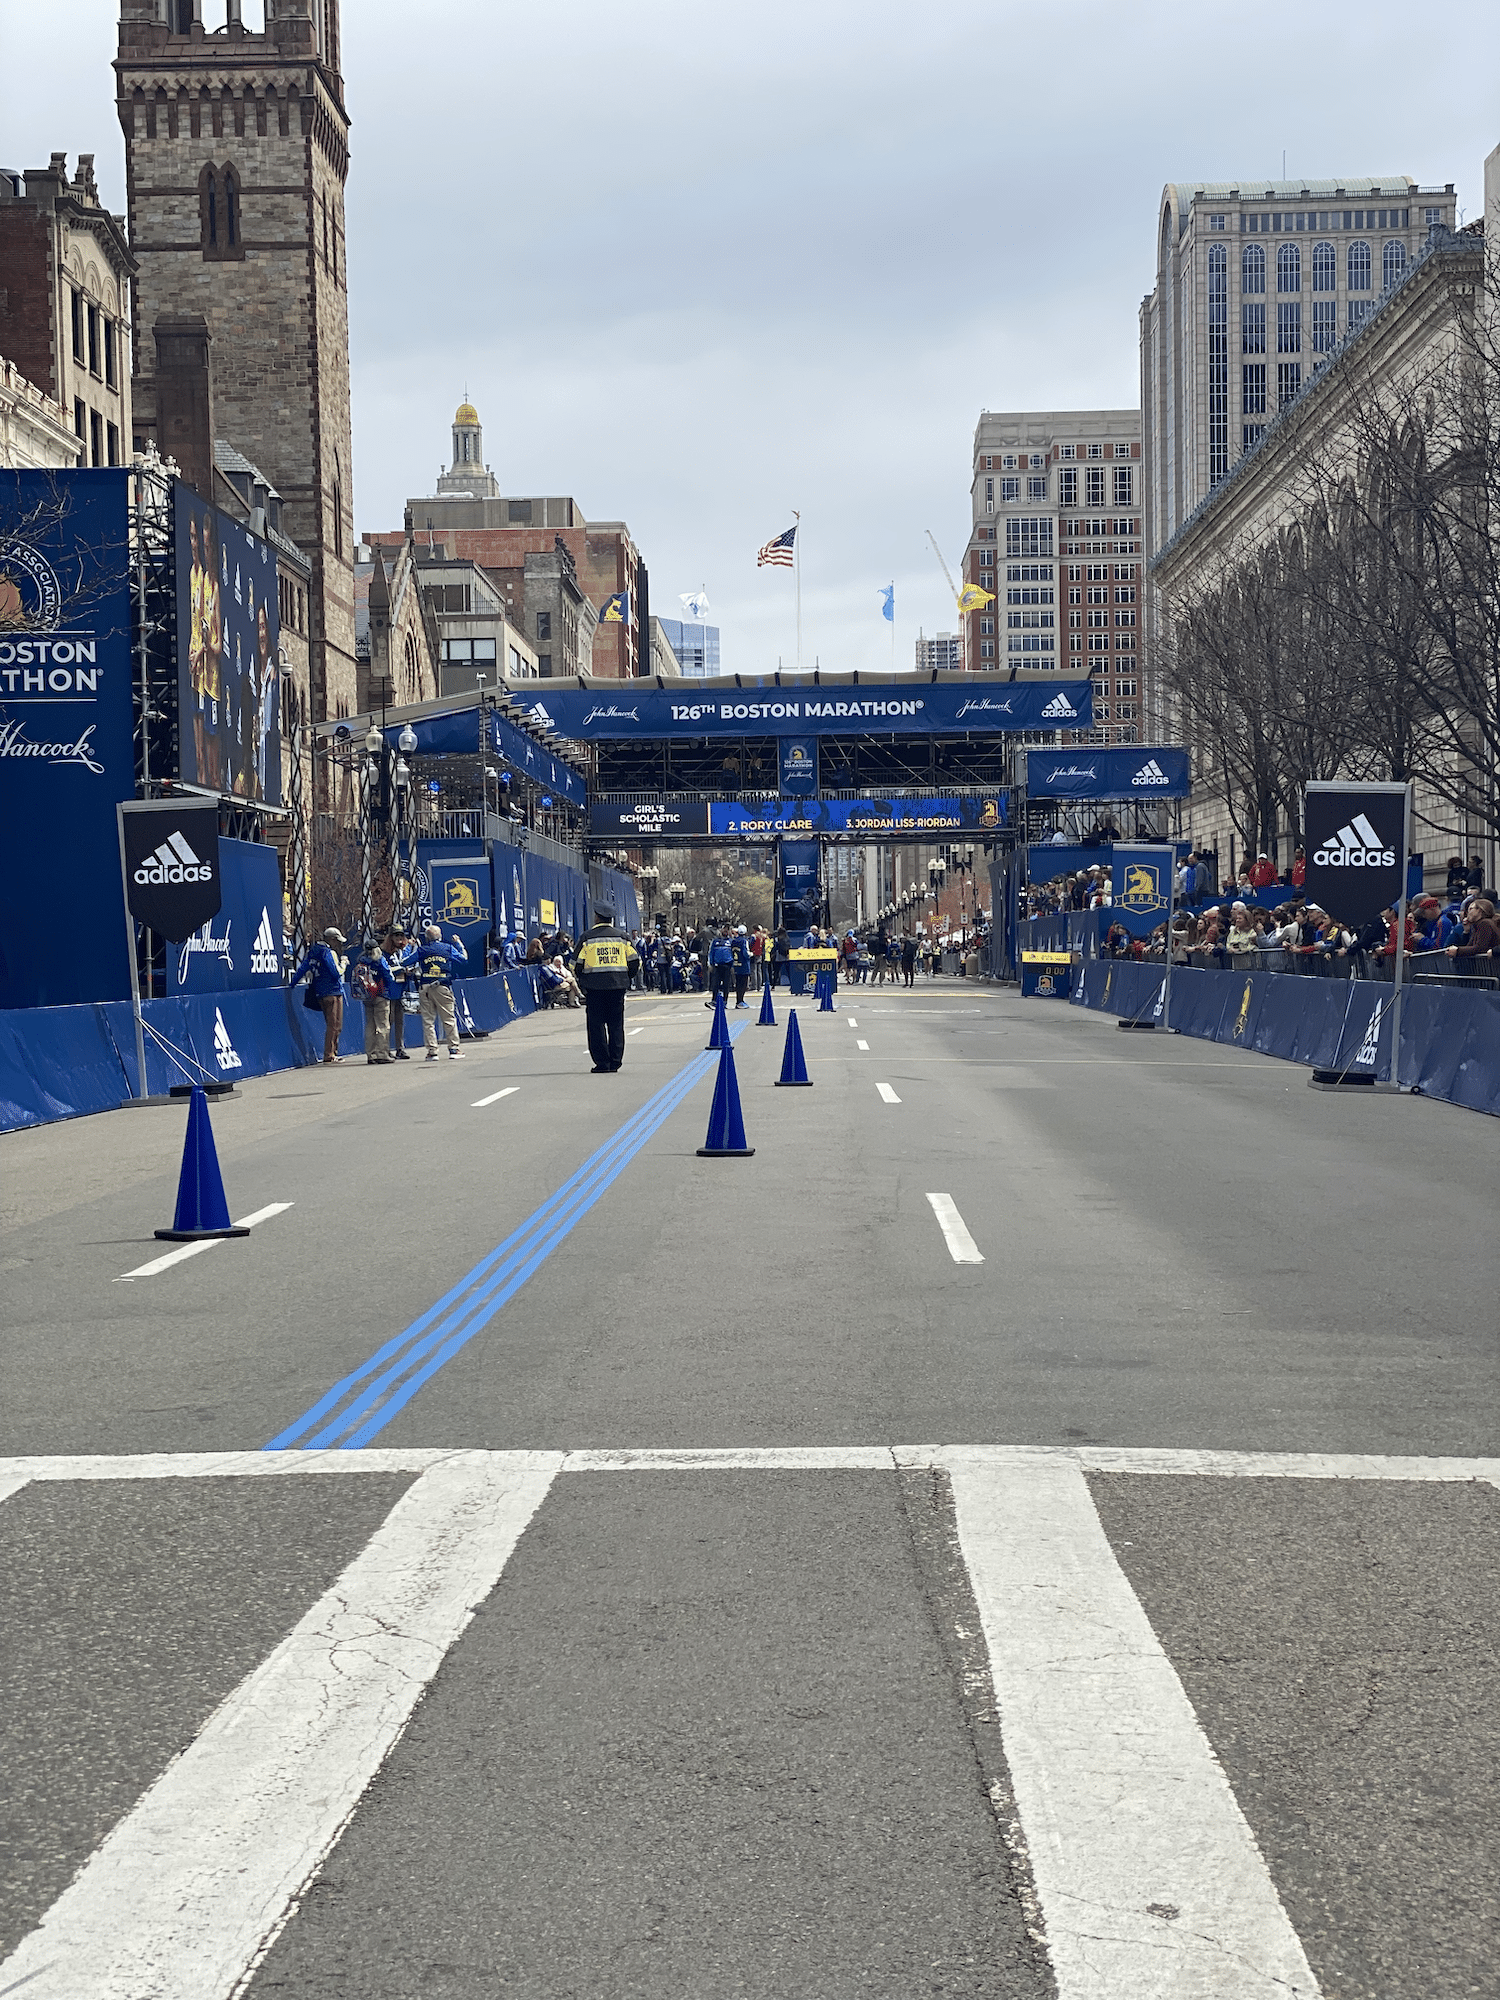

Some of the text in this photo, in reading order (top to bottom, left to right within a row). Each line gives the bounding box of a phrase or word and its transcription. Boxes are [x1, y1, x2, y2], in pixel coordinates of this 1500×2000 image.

[670, 704, 716, 720] 126TH
[720, 702, 800, 719] BOSTON
[1040, 708, 1078, 718] adidas
[1131, 775, 1170, 786] adidas
[634, 804, 666, 814] GIRL'S
[619, 813, 681, 824] SCHOLASTIC
[845, 817, 961, 829] 3. JORDAN LISS-RIORDAN
[638, 823, 663, 833] MILE
[728, 819, 813, 831] 2. RORY CLARE
[1312, 846, 1396, 867] adidas
[133, 864, 213, 885] adidas
[596, 947, 621, 956] BOSTON
[598, 955, 619, 965] POLICE
